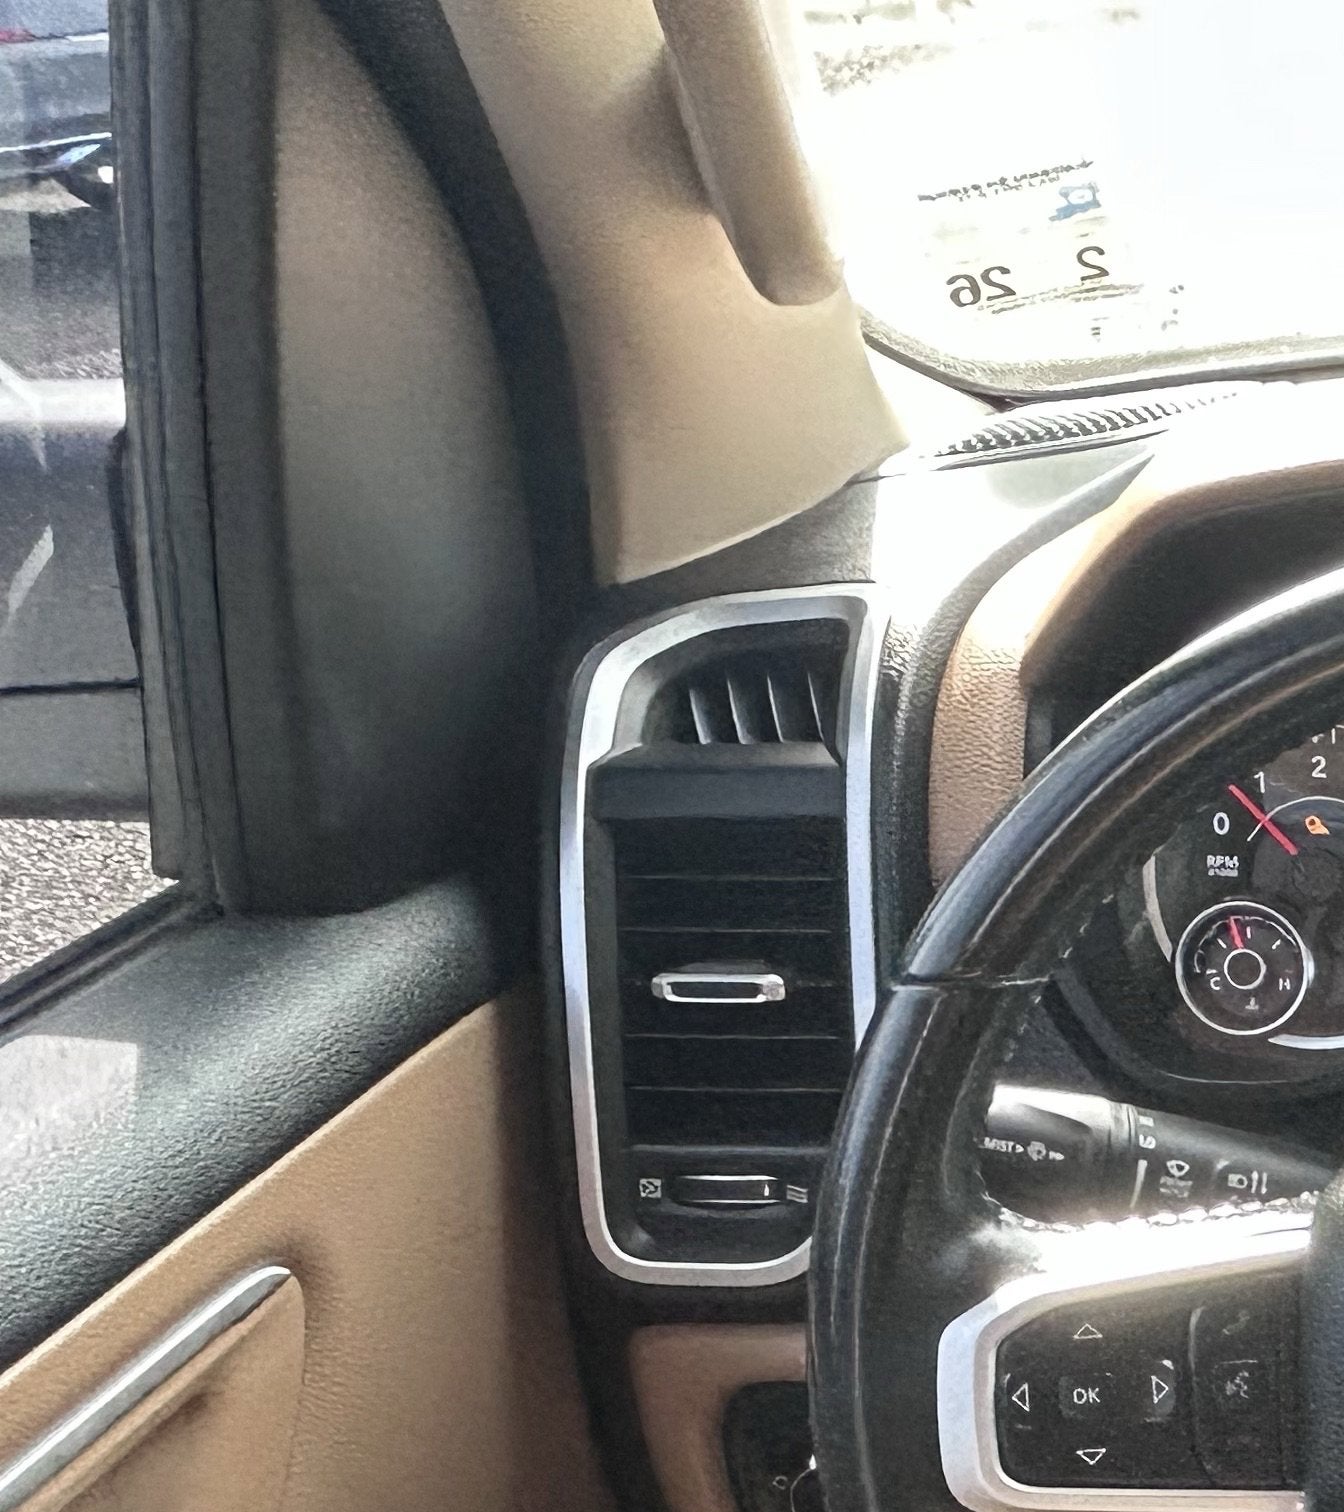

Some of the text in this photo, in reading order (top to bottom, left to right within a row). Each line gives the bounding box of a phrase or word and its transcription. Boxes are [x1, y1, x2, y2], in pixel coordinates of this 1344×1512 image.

[1311, 755, 1327, 779] 2
[1253, 771, 1266, 793] 1
[1212, 812, 1230, 835] 0
[1209, 976, 1221, 991] C
[1278, 977, 1291, 991] H
[1072, 1387, 1101, 1405] OK
